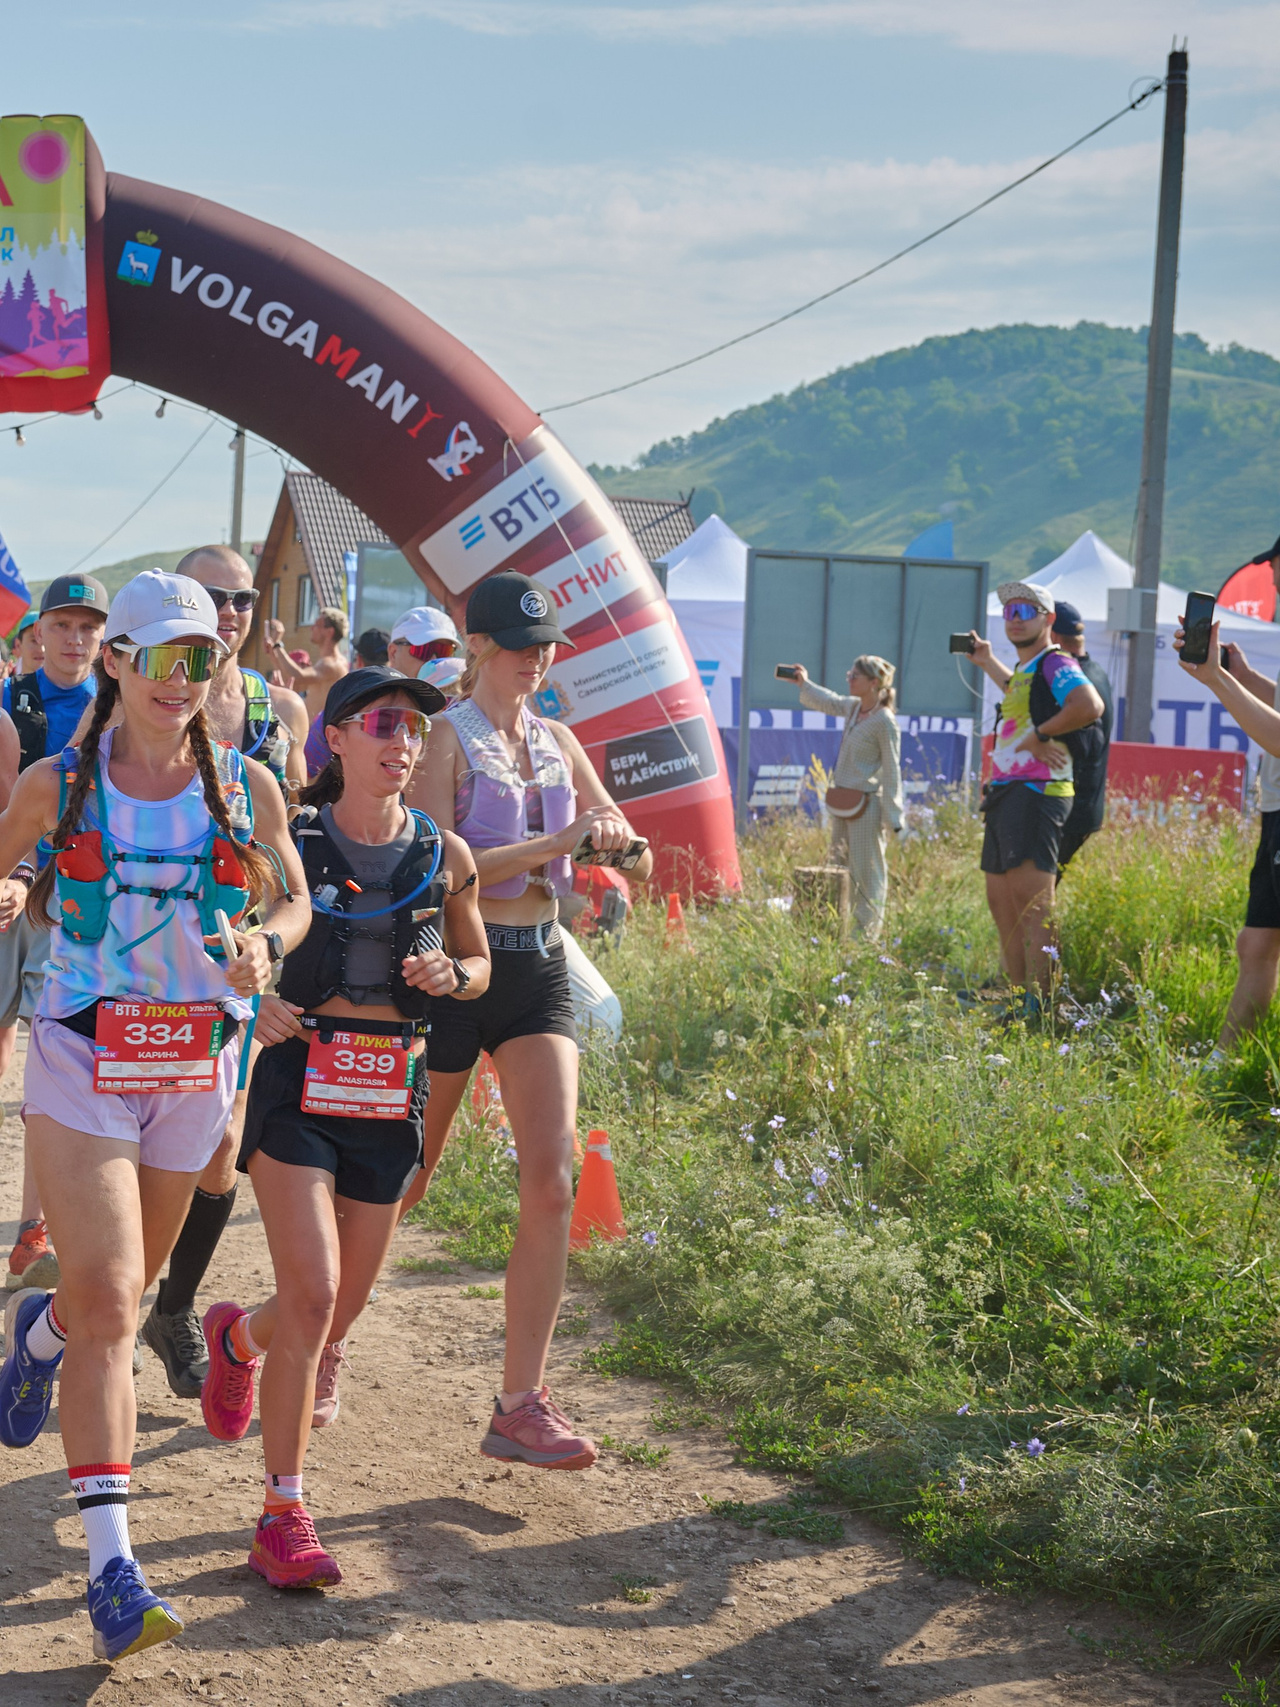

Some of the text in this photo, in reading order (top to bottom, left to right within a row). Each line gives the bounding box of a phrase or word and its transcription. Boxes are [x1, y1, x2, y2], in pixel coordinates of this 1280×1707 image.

[489, 477, 560, 542] ВТБ
[162, 594, 199, 610] FILA
[577, 669, 632, 699] Самарской
[610, 751, 649, 771] БЕРИ
[614, 753, 701, 787] И ДЕЙСТВУЙ!
[360, 861, 387, 873] TYR
[115, 1004, 140, 1016] ВТБ
[144, 1005, 188, 1017] ЛУКА
[124, 1023, 195, 1045] 334
[210, 1022, 221, 1056] ТРЕЙЛ
[354, 1035, 392, 1049] ЛУКА
[138, 1051, 180, 1059] КАРИНА
[333, 1050, 396, 1074] 339
[405, 1053, 414, 1086] ТРЕЙЛ
[337, 1076, 387, 1086] ANASTASIIA
